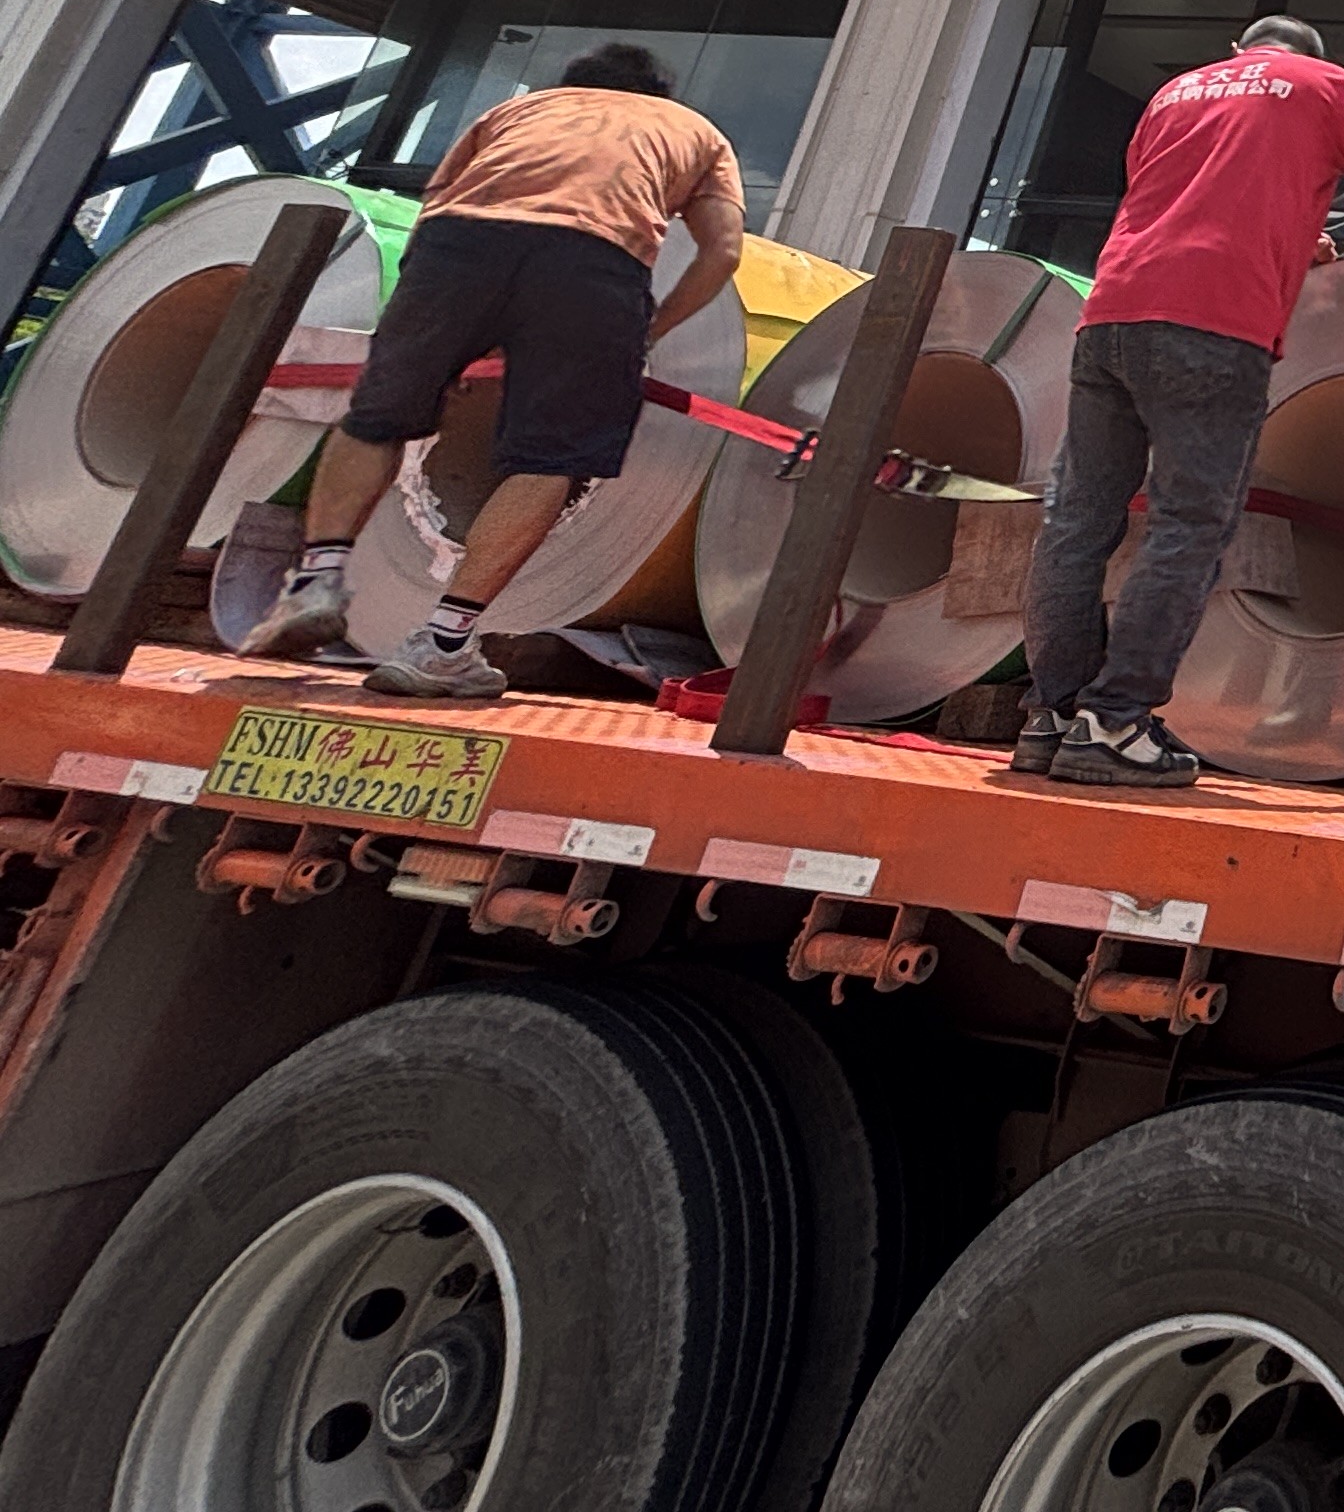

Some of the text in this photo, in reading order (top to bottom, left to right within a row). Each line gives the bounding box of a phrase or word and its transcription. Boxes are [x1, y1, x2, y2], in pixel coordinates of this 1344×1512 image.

[227, 715, 492, 787] FSHM 佛山华美
